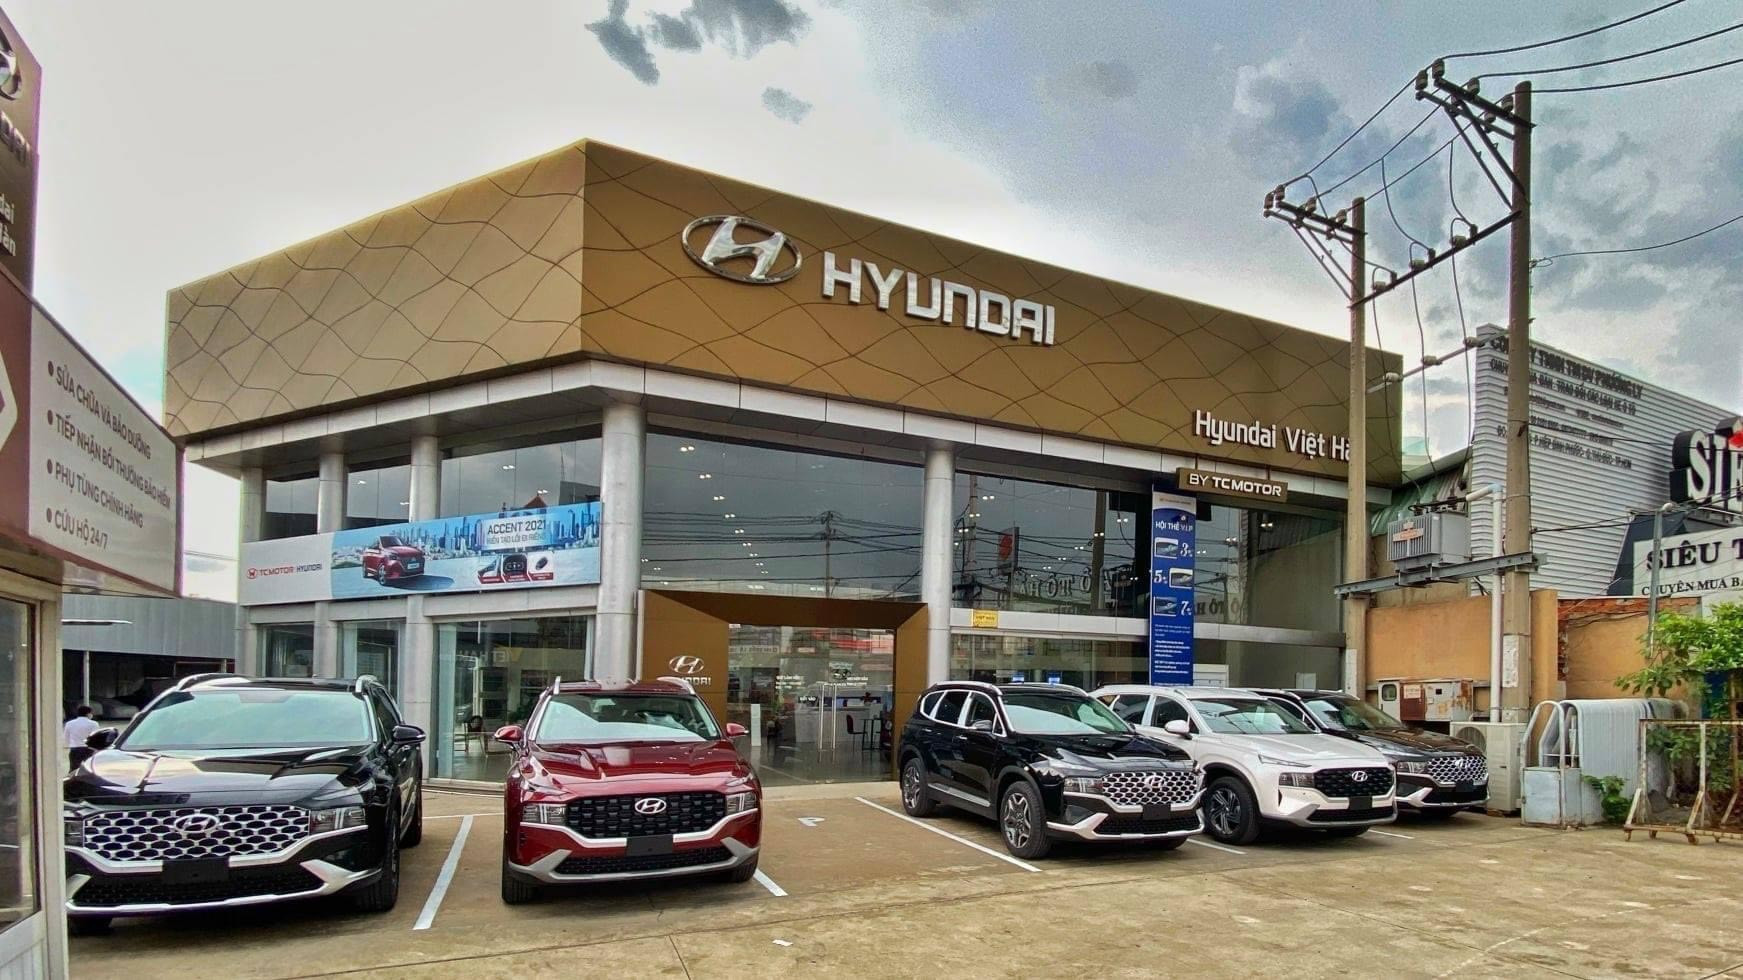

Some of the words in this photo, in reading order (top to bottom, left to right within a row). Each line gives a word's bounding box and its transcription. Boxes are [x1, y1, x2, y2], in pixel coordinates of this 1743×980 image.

[822, 250, 1055, 346] HYUNDAI
[56, 364, 75, 398] SỬA
[76, 384, 100, 419] CHỮA
[56, 412, 76, 442] TIẾP
[77, 429, 101, 462] NHẬN
[1195, 409, 1276, 449] Hyundai
[1285, 426, 1325, 460] Việt
[56, 462, 74, 493] PHỤ
[77, 472, 99, 503] TÙNG
[100, 490, 123, 518] CHÍNH
[124, 503, 143, 529] HÀNG
[1189, 472, 1208, 486] BY
[55, 508, 74, 535] CỨU
[77, 518, 89, 546] HỘ
[90, 526, 108, 550] 24/7
[487, 521, 523, 535] ACCENT
[525, 519, 546, 532] 2021
[1646, 539, 1722, 570] SIÊU
[1641, 580, 1694, 596] CUYÊN
[1697, 579, 1728, 591] MUA
